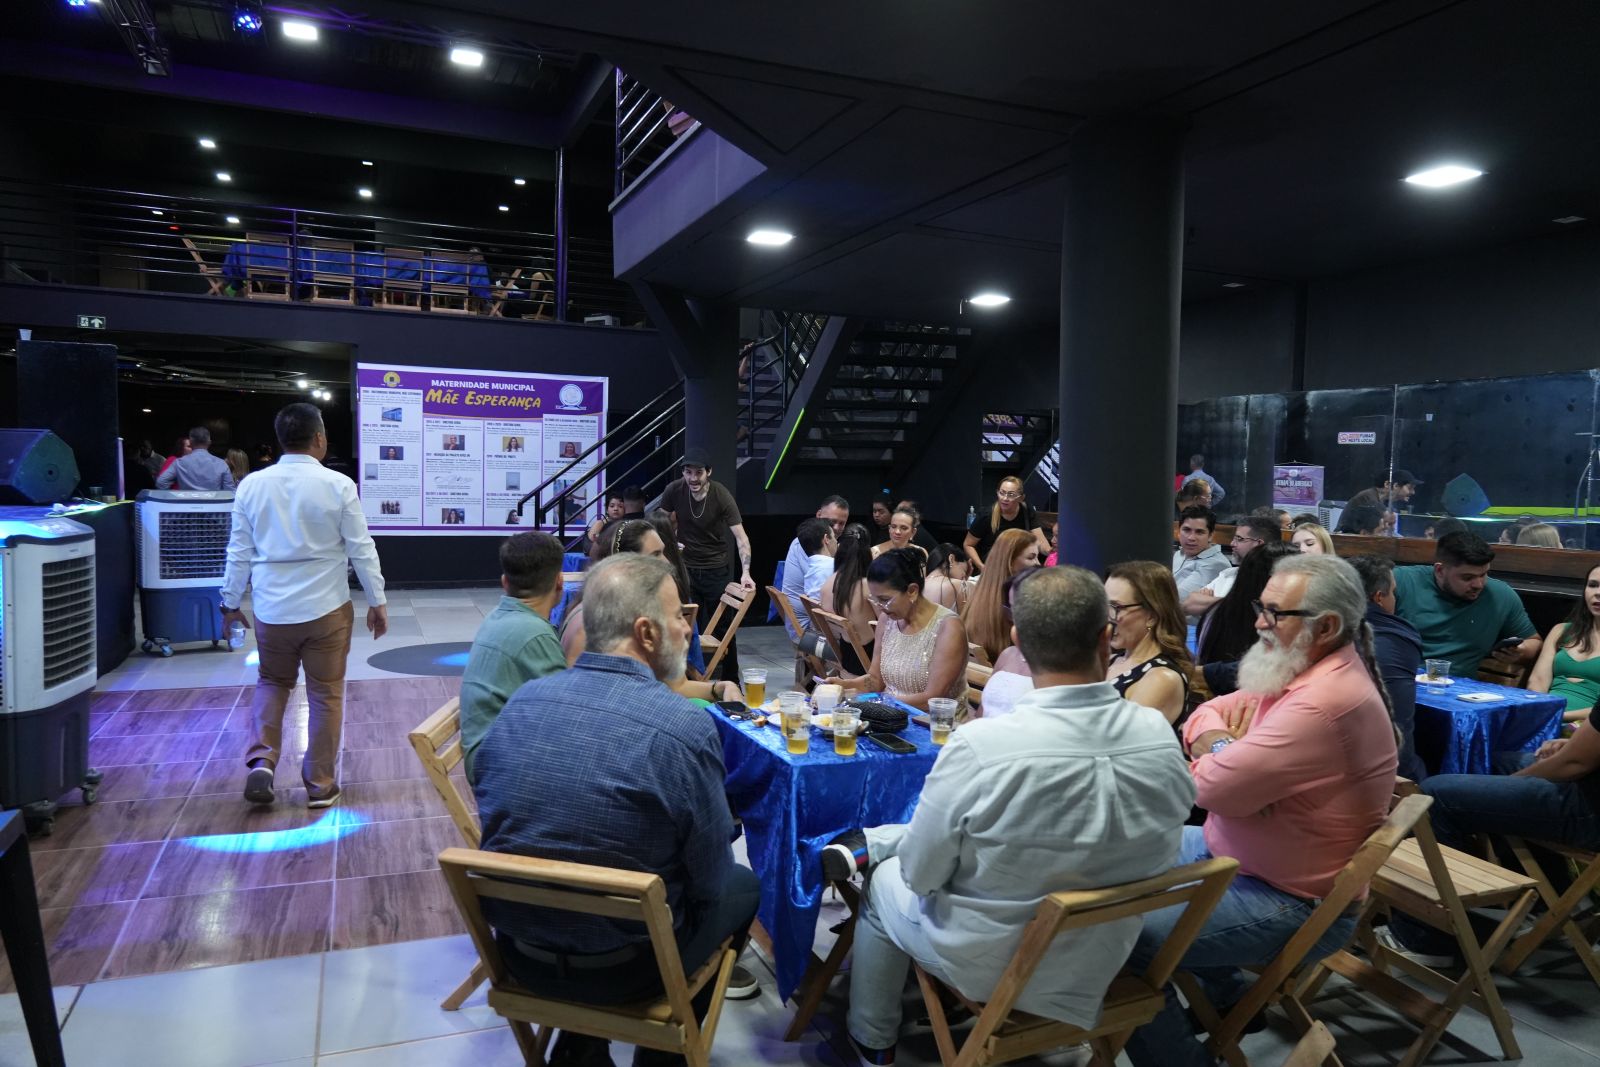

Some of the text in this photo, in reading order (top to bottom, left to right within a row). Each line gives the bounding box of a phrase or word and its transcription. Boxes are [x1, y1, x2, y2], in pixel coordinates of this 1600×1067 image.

[431, 379, 535, 392] MATERNIDADE MUNICIPAL
[425, 388, 459, 404] MÃE
[465, 391, 541, 410] ESPERANÇA
